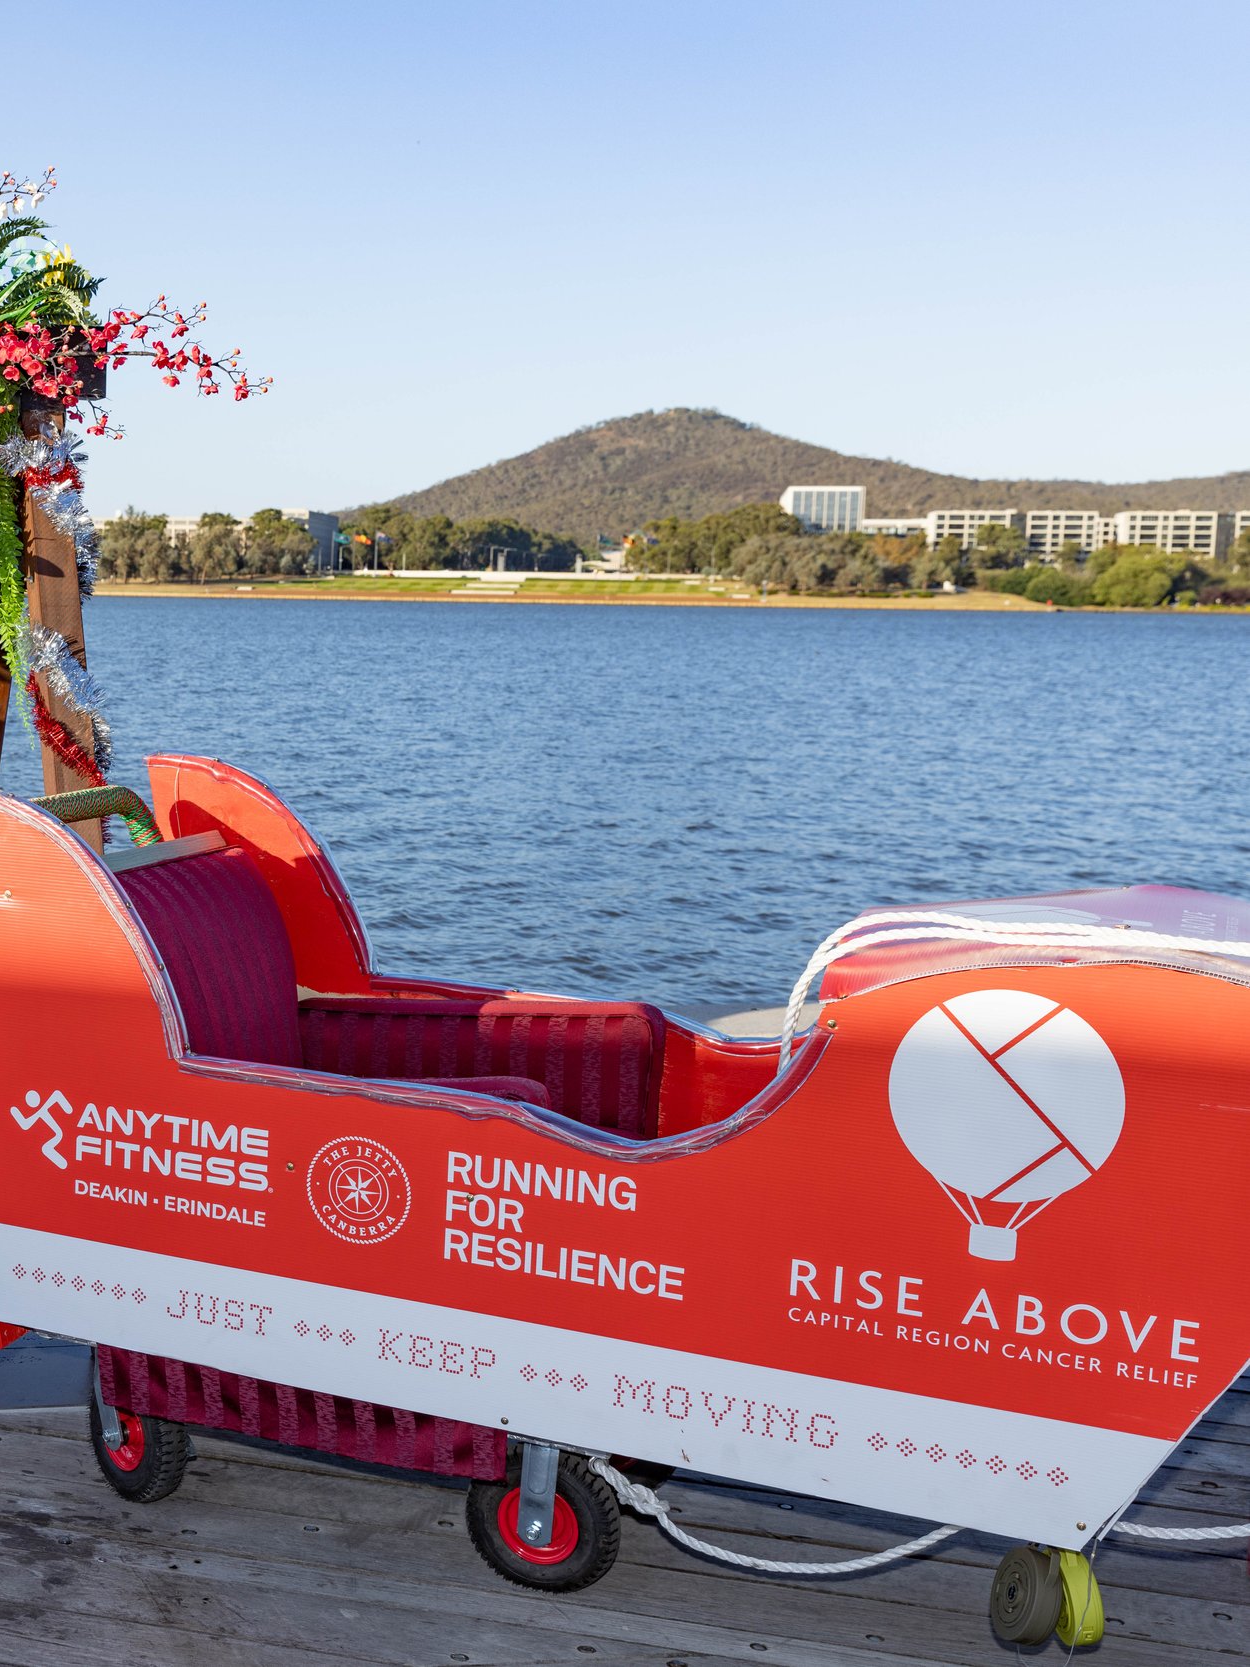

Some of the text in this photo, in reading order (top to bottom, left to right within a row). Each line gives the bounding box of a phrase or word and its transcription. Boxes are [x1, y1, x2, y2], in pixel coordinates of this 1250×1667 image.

[77, 1103, 269, 1157] ANYTIME
[323, 1146, 397, 1177] THE JETTY
[448, 1151, 637, 1211] RUNNING
[75, 1180, 266, 1227] DEAKIN ERINDALE
[323, 1205, 396, 1236] CANBERRA
[445, 1190, 524, 1233] FOR
[444, 1228, 685, 1301] RESILIENCE
[789, 1259, 1200, 1363] RISE ABOVE
[166, 1289, 838, 1449] JUST KEEP MOVING
[788, 1308, 1198, 1389] CAPITAL REGION CANCER RELIEF
